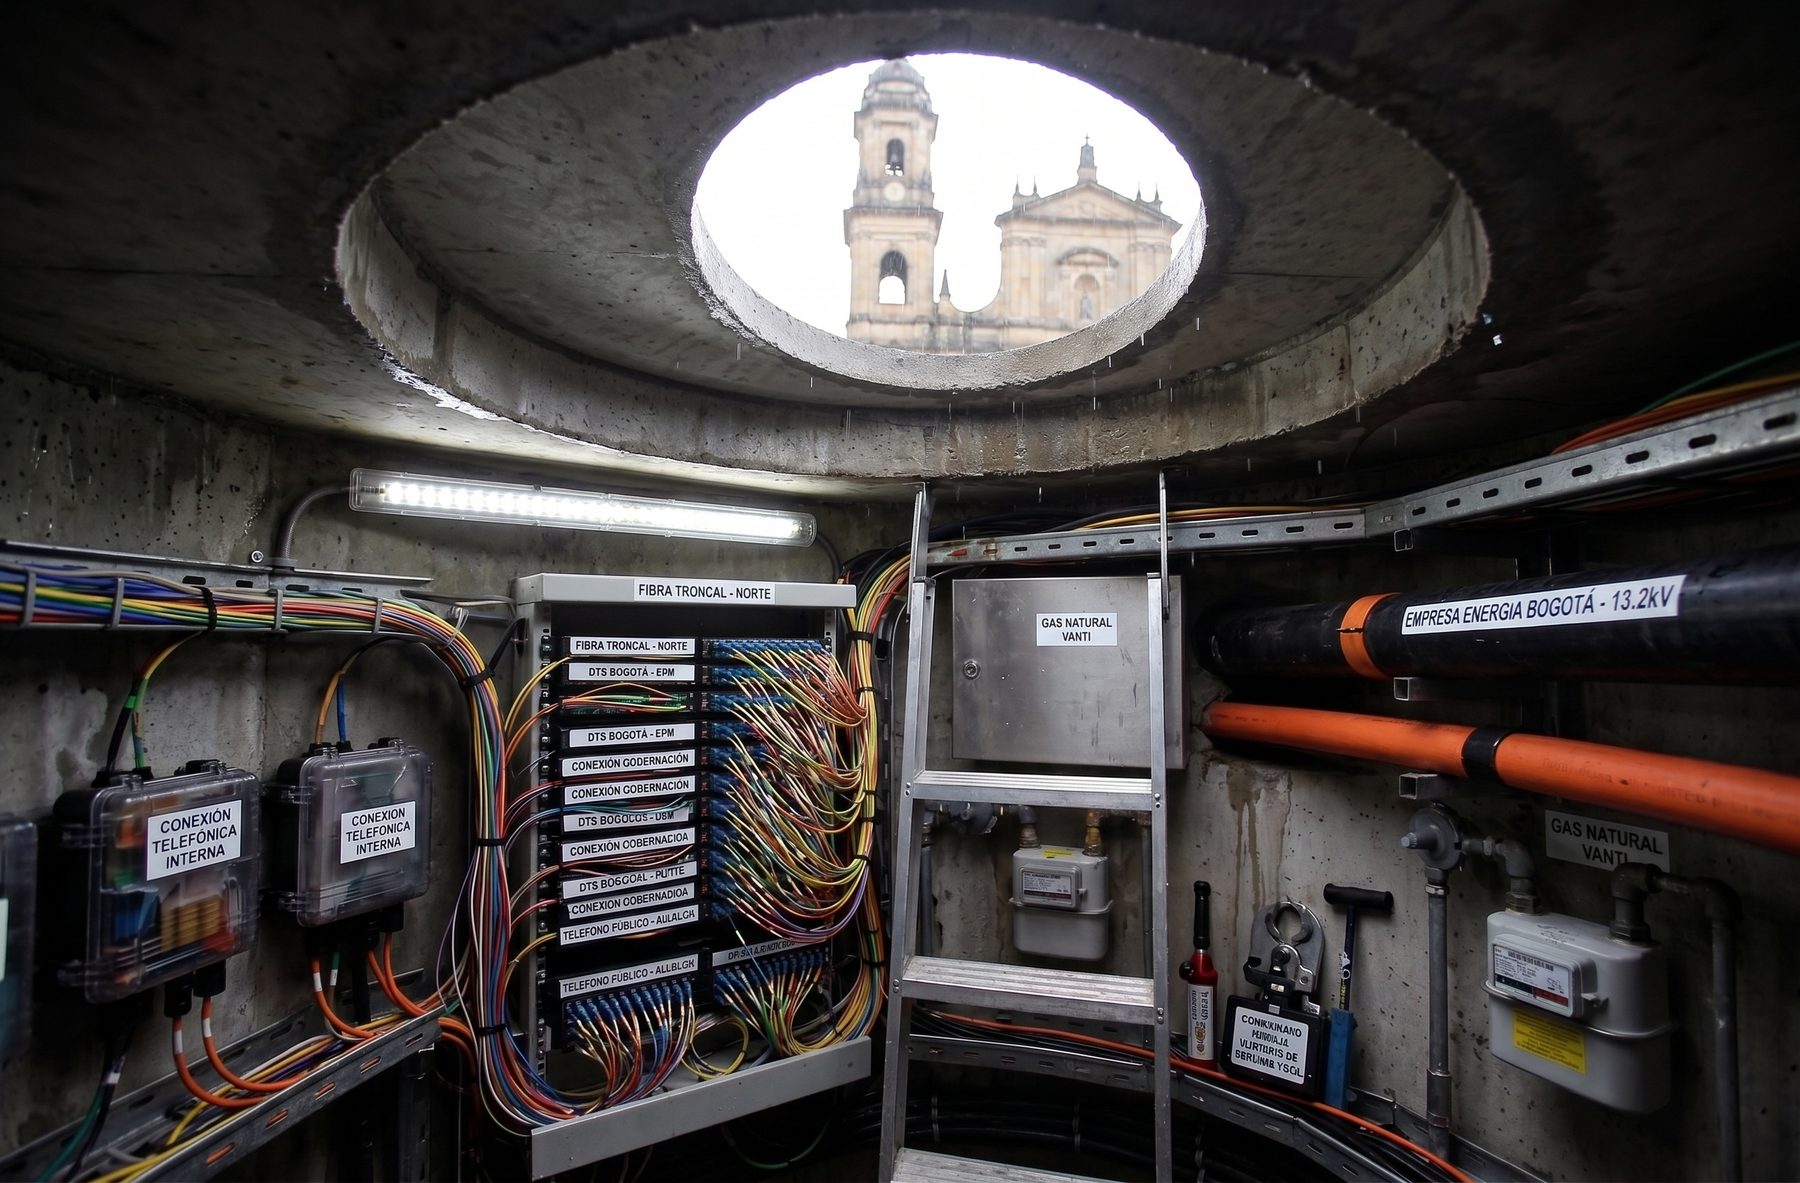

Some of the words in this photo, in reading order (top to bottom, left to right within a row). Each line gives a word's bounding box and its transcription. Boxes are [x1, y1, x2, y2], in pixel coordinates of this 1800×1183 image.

[638, 584, 672, 597] FIBRA
[675, 585, 727, 598] TRONCAL
[736, 587, 771, 600] NORTE
[1405, 608, 1460, 628] EMPRESA
[1463, 603, 1522, 623] ENERGIA
[1526, 588, 1595, 618] BOGOTÁ
[1611, 585, 1674, 611] 13.2kV
[1041, 618, 1063, 628] GAS
[1065, 617, 1112, 628] NATURAL
[1062, 631, 1091, 641] VANTI
[575, 640, 604, 651] FIBRA
[606, 641, 650, 651] TRONCAL
[658, 641, 688, 651] NORTE
[589, 667, 607, 676] DTS
[610, 666, 648, 677] BOGOTÁ
[656, 668, 675, 677] EPM
[588, 732, 606, 742] DTS
[609, 729, 648, 741] BOGOTÁ
[656, 728, 675, 737] EPM
[572, 757, 621, 772] CONEXIÓN
[572, 785, 621, 799] CONEXIÓN
[623, 779, 689, 794] GOBERNACIÓN
[161, 808, 231, 834] CONEXIÓN
[352, 808, 405, 826] CONEXION
[578, 817, 597, 827] DTS
[152, 824, 237, 854] TELEFÓNICA
[346, 821, 410, 842] TELEFONICA
[1551, 818, 1582, 837] GAS
[1586, 824, 1663, 855] NATURAL
[357, 837, 401, 855] INTERNA
[570, 840, 620, 856] CONEXIÓN
[166, 844, 225, 869] INTERNA
[579, 880, 598, 893] DTS
[563, 925, 610, 940] TELEFONO
[563, 977, 610, 993] TELEFONO
[1286, 1052, 1298, 1062] DE
